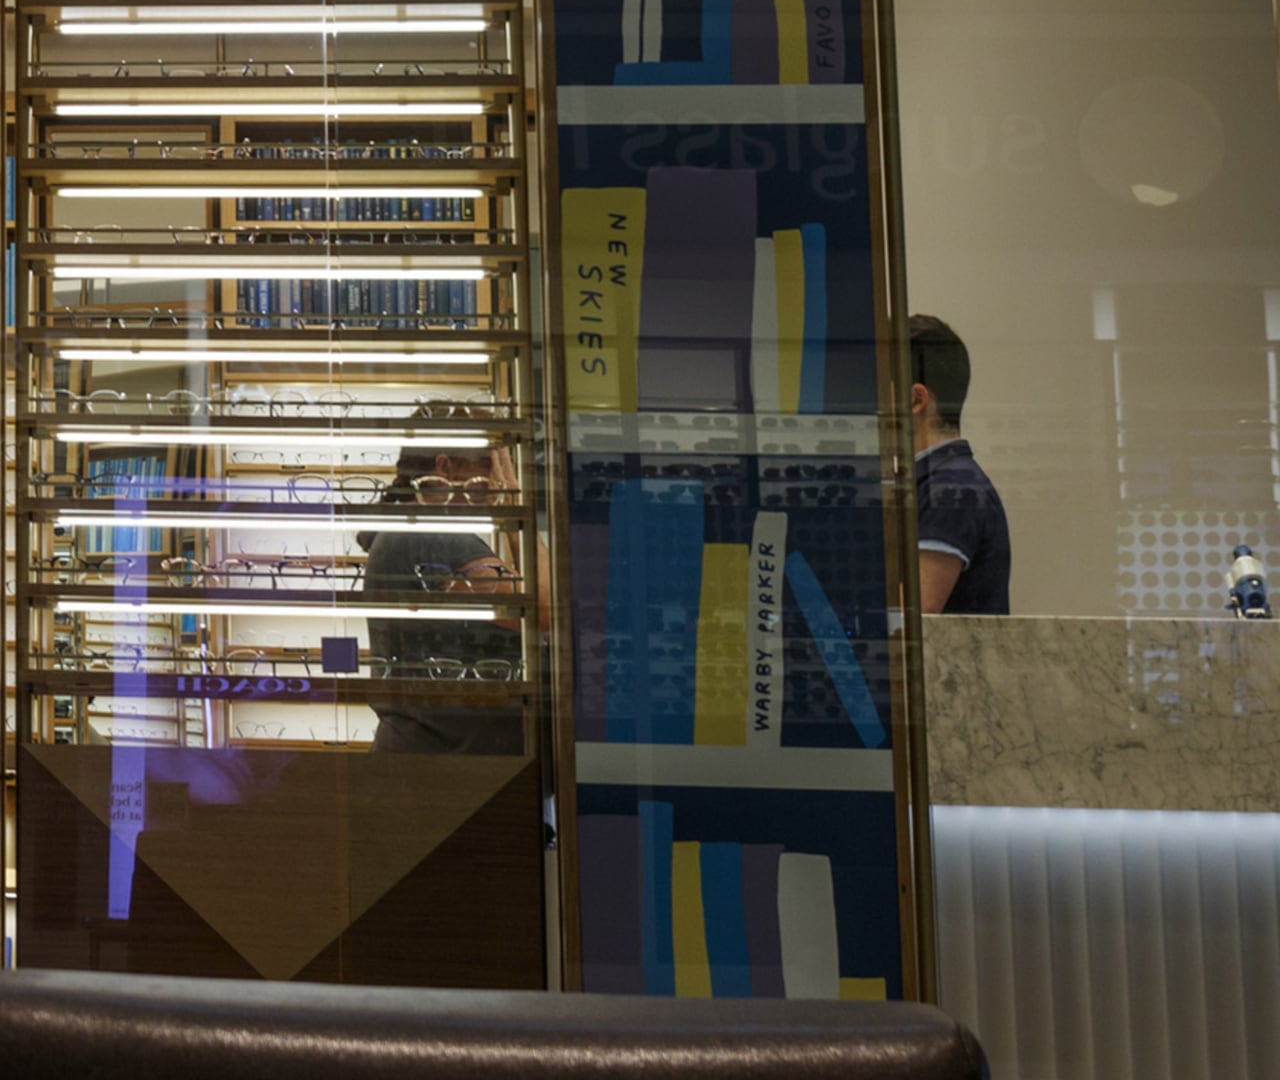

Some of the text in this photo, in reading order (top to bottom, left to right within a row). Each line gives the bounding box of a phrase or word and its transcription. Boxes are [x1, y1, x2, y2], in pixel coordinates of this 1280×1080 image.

[606, 212, 629, 288] NEW
[577, 262, 606, 377] SKIES
[754, 541, 777, 732] WARBY PARKER
